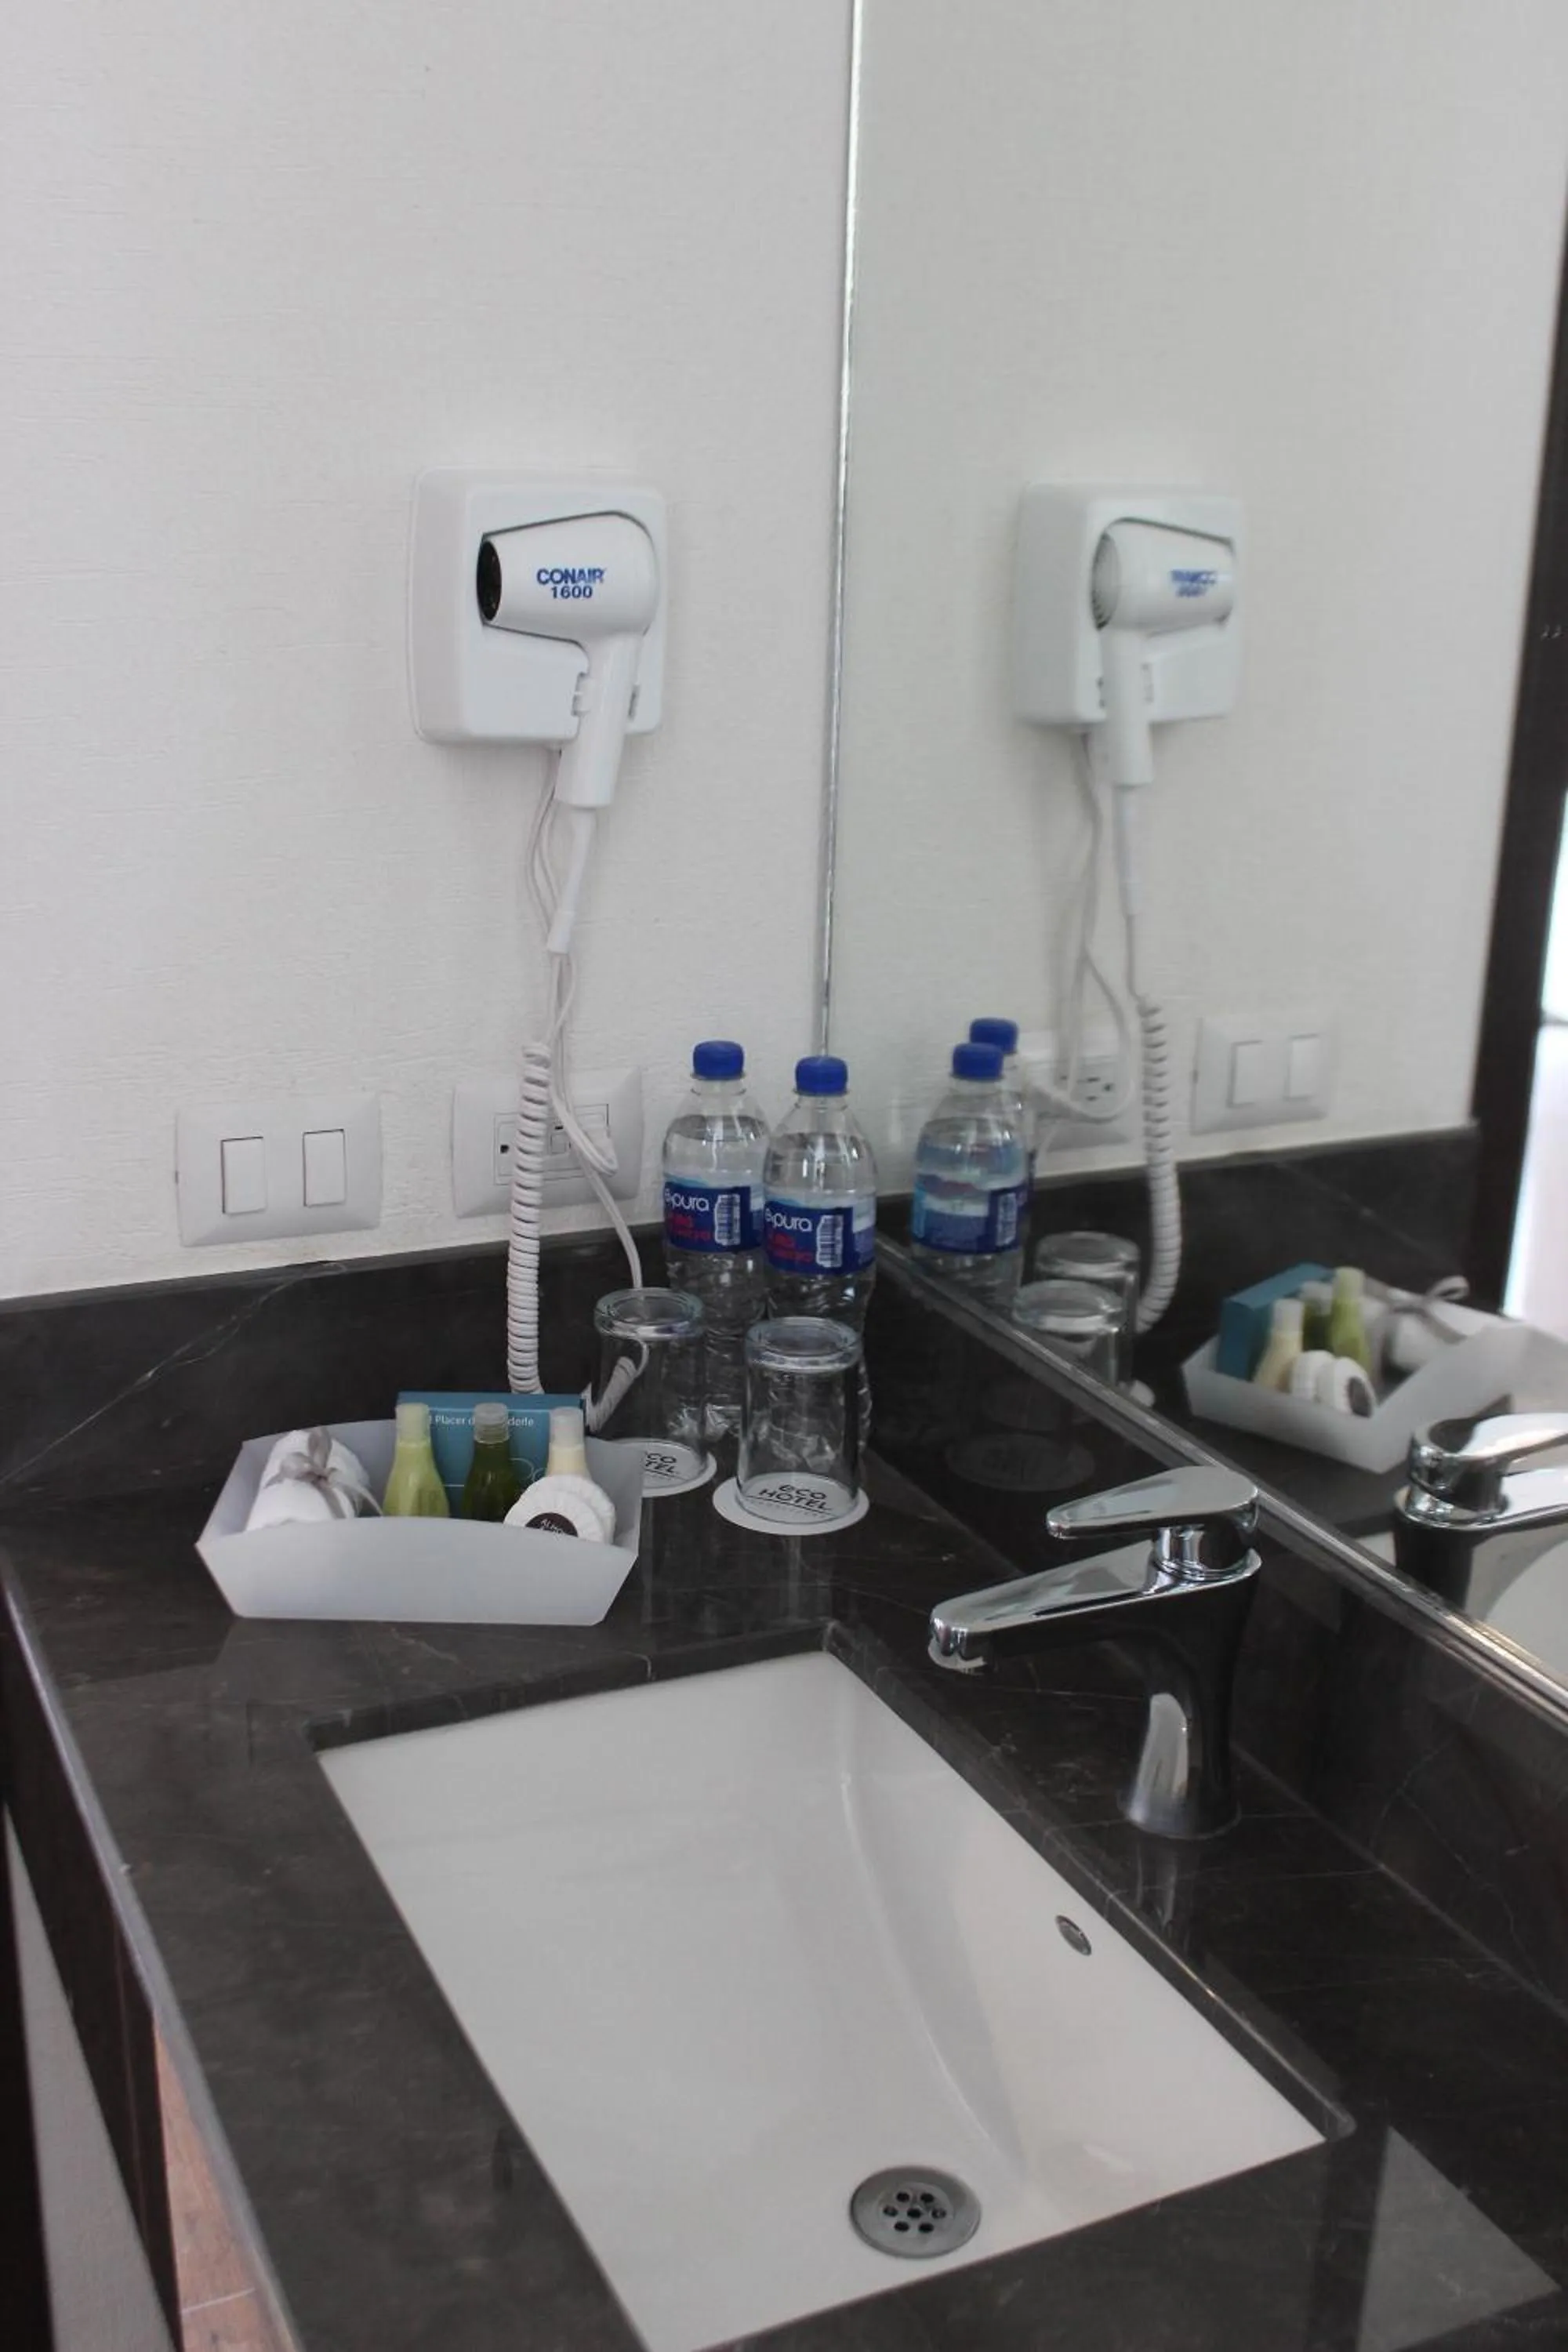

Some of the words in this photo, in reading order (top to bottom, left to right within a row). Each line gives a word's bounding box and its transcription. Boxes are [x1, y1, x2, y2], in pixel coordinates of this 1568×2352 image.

[536, 568, 604, 585] CONAIR
[551, 585, 593, 599] 1600
[434, 1414, 466, 1425] Placer
[645, 1452, 677, 1463] CO
[645, 1460, 679, 1473] TEL
[759, 1489, 833, 1511] HOTEL
